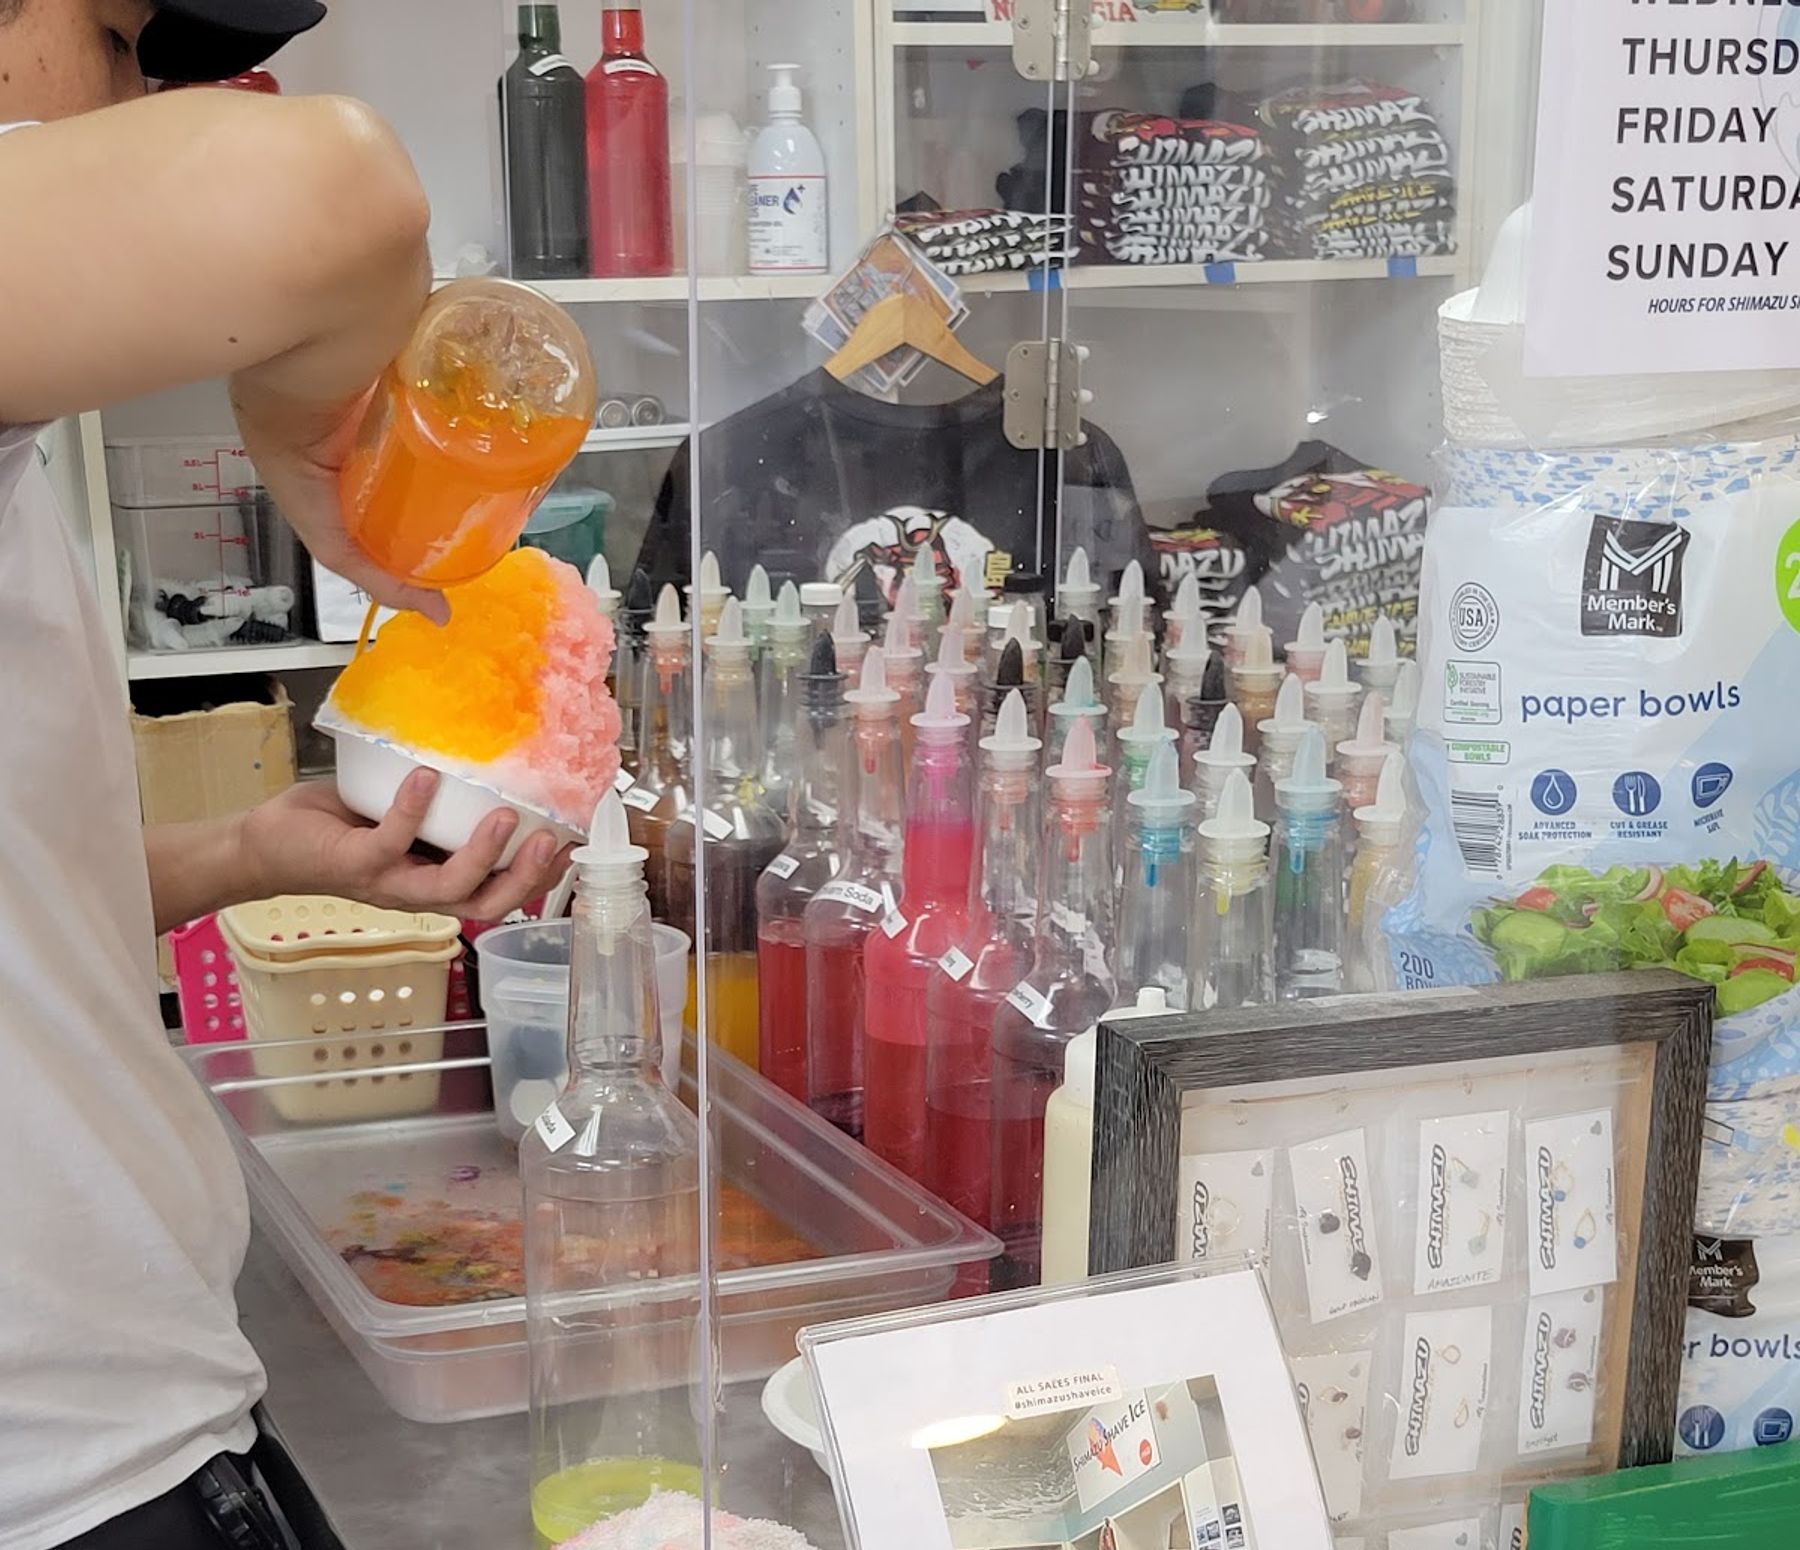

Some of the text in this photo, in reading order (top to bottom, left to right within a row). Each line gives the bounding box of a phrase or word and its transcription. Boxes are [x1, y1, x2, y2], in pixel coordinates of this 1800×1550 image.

[1617, 107, 1777, 144] FRIDAY
[1606, 241, 1789, 281] SUNDAY
[1648, 297, 1695, 314] HOURS
[1697, 296, 1725, 312] FOR
[1727, 295, 1788, 312] SHIMAZU
[1587, 594, 1677, 615] Member's
[1460, 607, 1484, 627] USA
[1608, 613, 1656, 631] Mark
[1521, 681, 1740, 724] paper bowls
[1451, 742, 1505, 753] COMPOSTABLE
[1464, 752, 1491, 761] BOWLS
[1533, 820, 1576, 831] ADVANCED
[1609, 820, 1627, 830] CUT
[1636, 820, 1669, 830] GREASE
[1616, 830, 1663, 839] RESISTANT
[1518, 831, 1592, 841] SOAK PROTECTION
[843, 886, 875, 906] Soda
[1400, 951, 1435, 980] 200
[1427, 1143, 1447, 1270] SHIMAZU
[1538, 1145, 1556, 1270] SHIMAZU
[1700, 1276, 1733, 1288] Mark
[1530, 1311, 1552, 1430] SHIMAZU
[1016, 1372, 1104, 1396] ALL SALES FINAL
[1404, 1336, 1431, 1457] SHIMAZU
